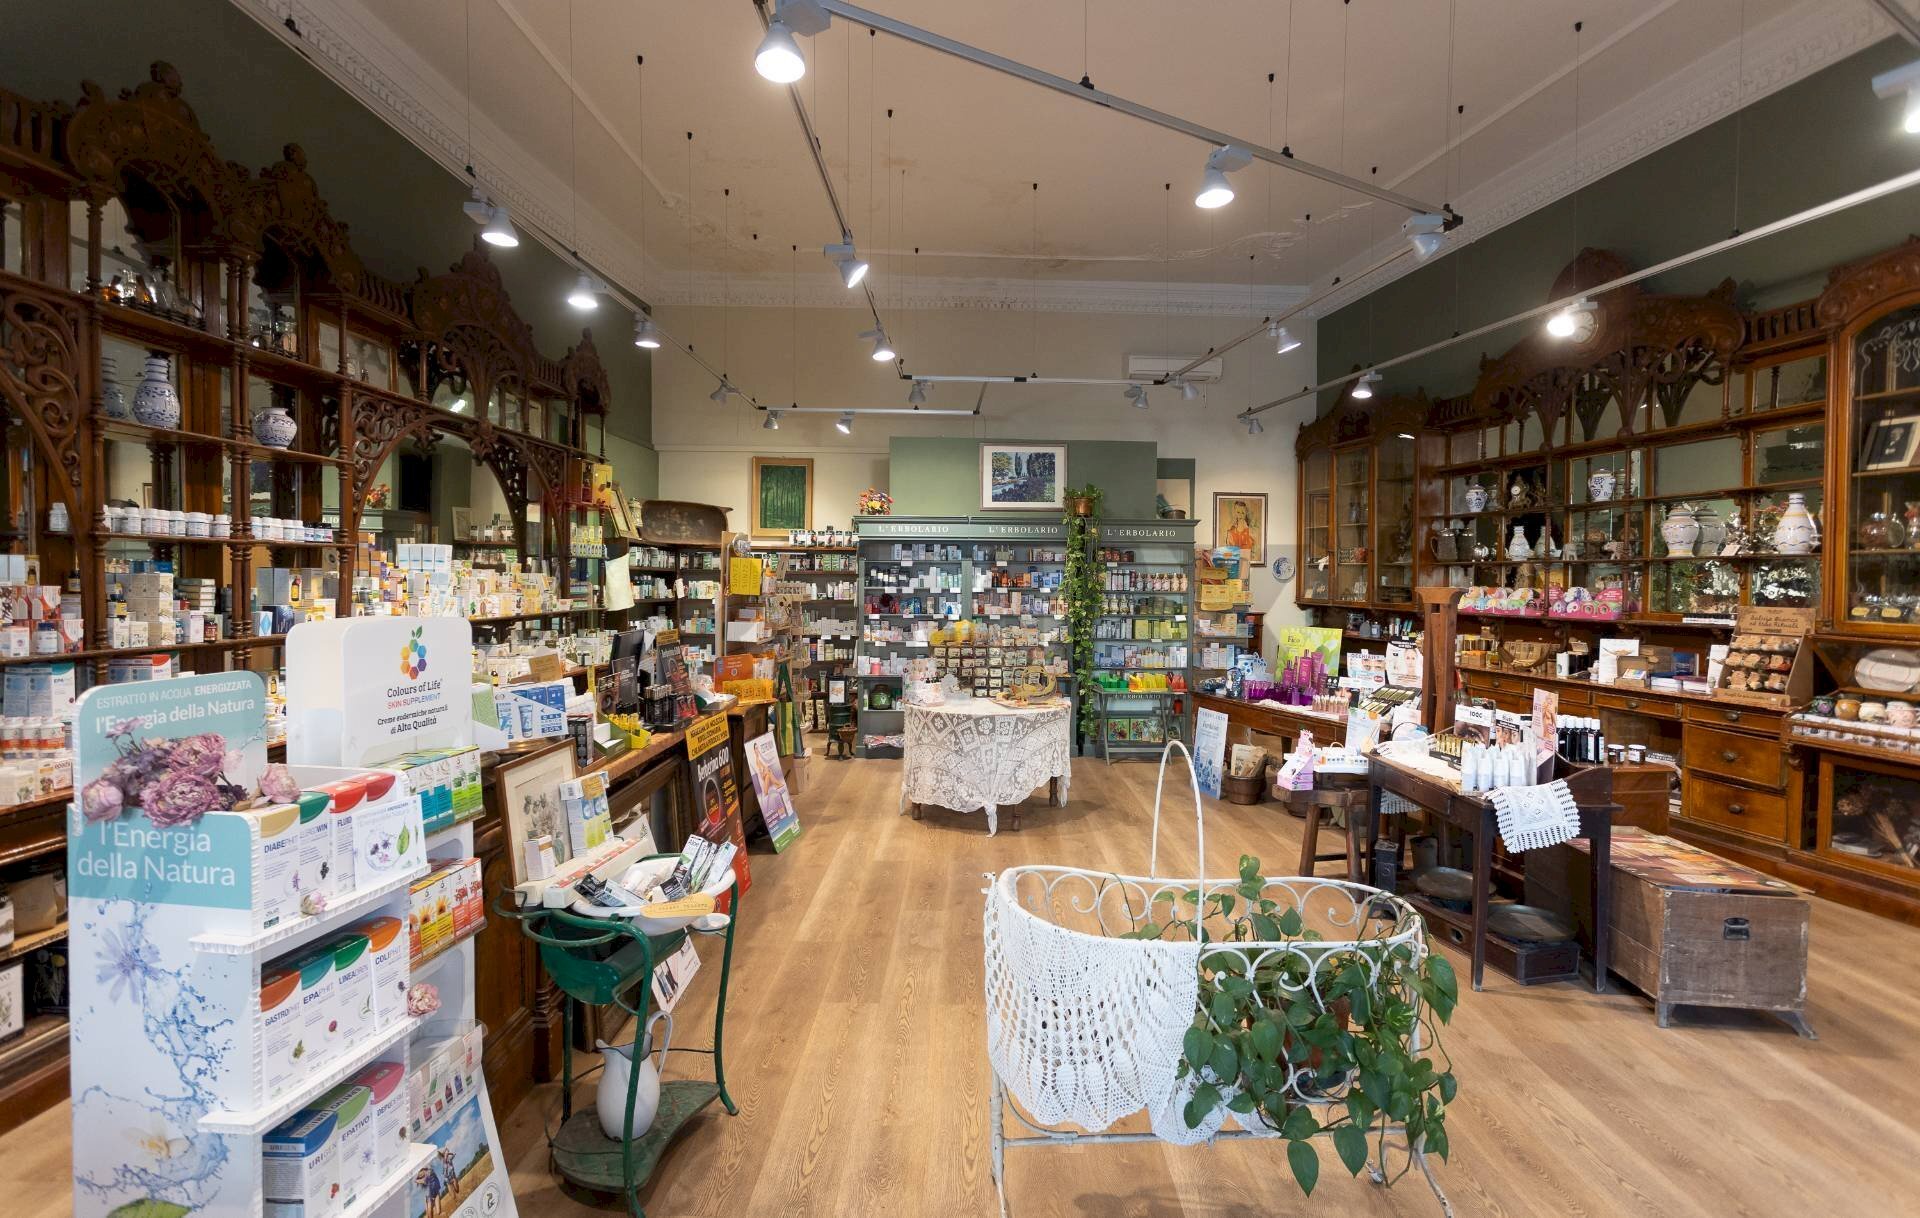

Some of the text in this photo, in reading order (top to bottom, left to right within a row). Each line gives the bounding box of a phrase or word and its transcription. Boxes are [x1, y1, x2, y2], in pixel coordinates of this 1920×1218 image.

[989, 526, 1058, 534] L'ERBOLARIO
[1107, 529, 1176, 537] L'ERBOLARIO
[96, 680, 252, 709] ESTRATTO IN ACQUA ENERGIZZATA
[387, 680, 441, 698] Colours of Life
[388, 693, 440, 709] SKIN SUPPLEMENT
[170, 704, 204, 722] della
[208, 699, 255, 716] Natura
[397, 721, 412, 732] Alta
[101, 820, 211, 856] l'Energia
[77, 851, 235, 886] della Natura
